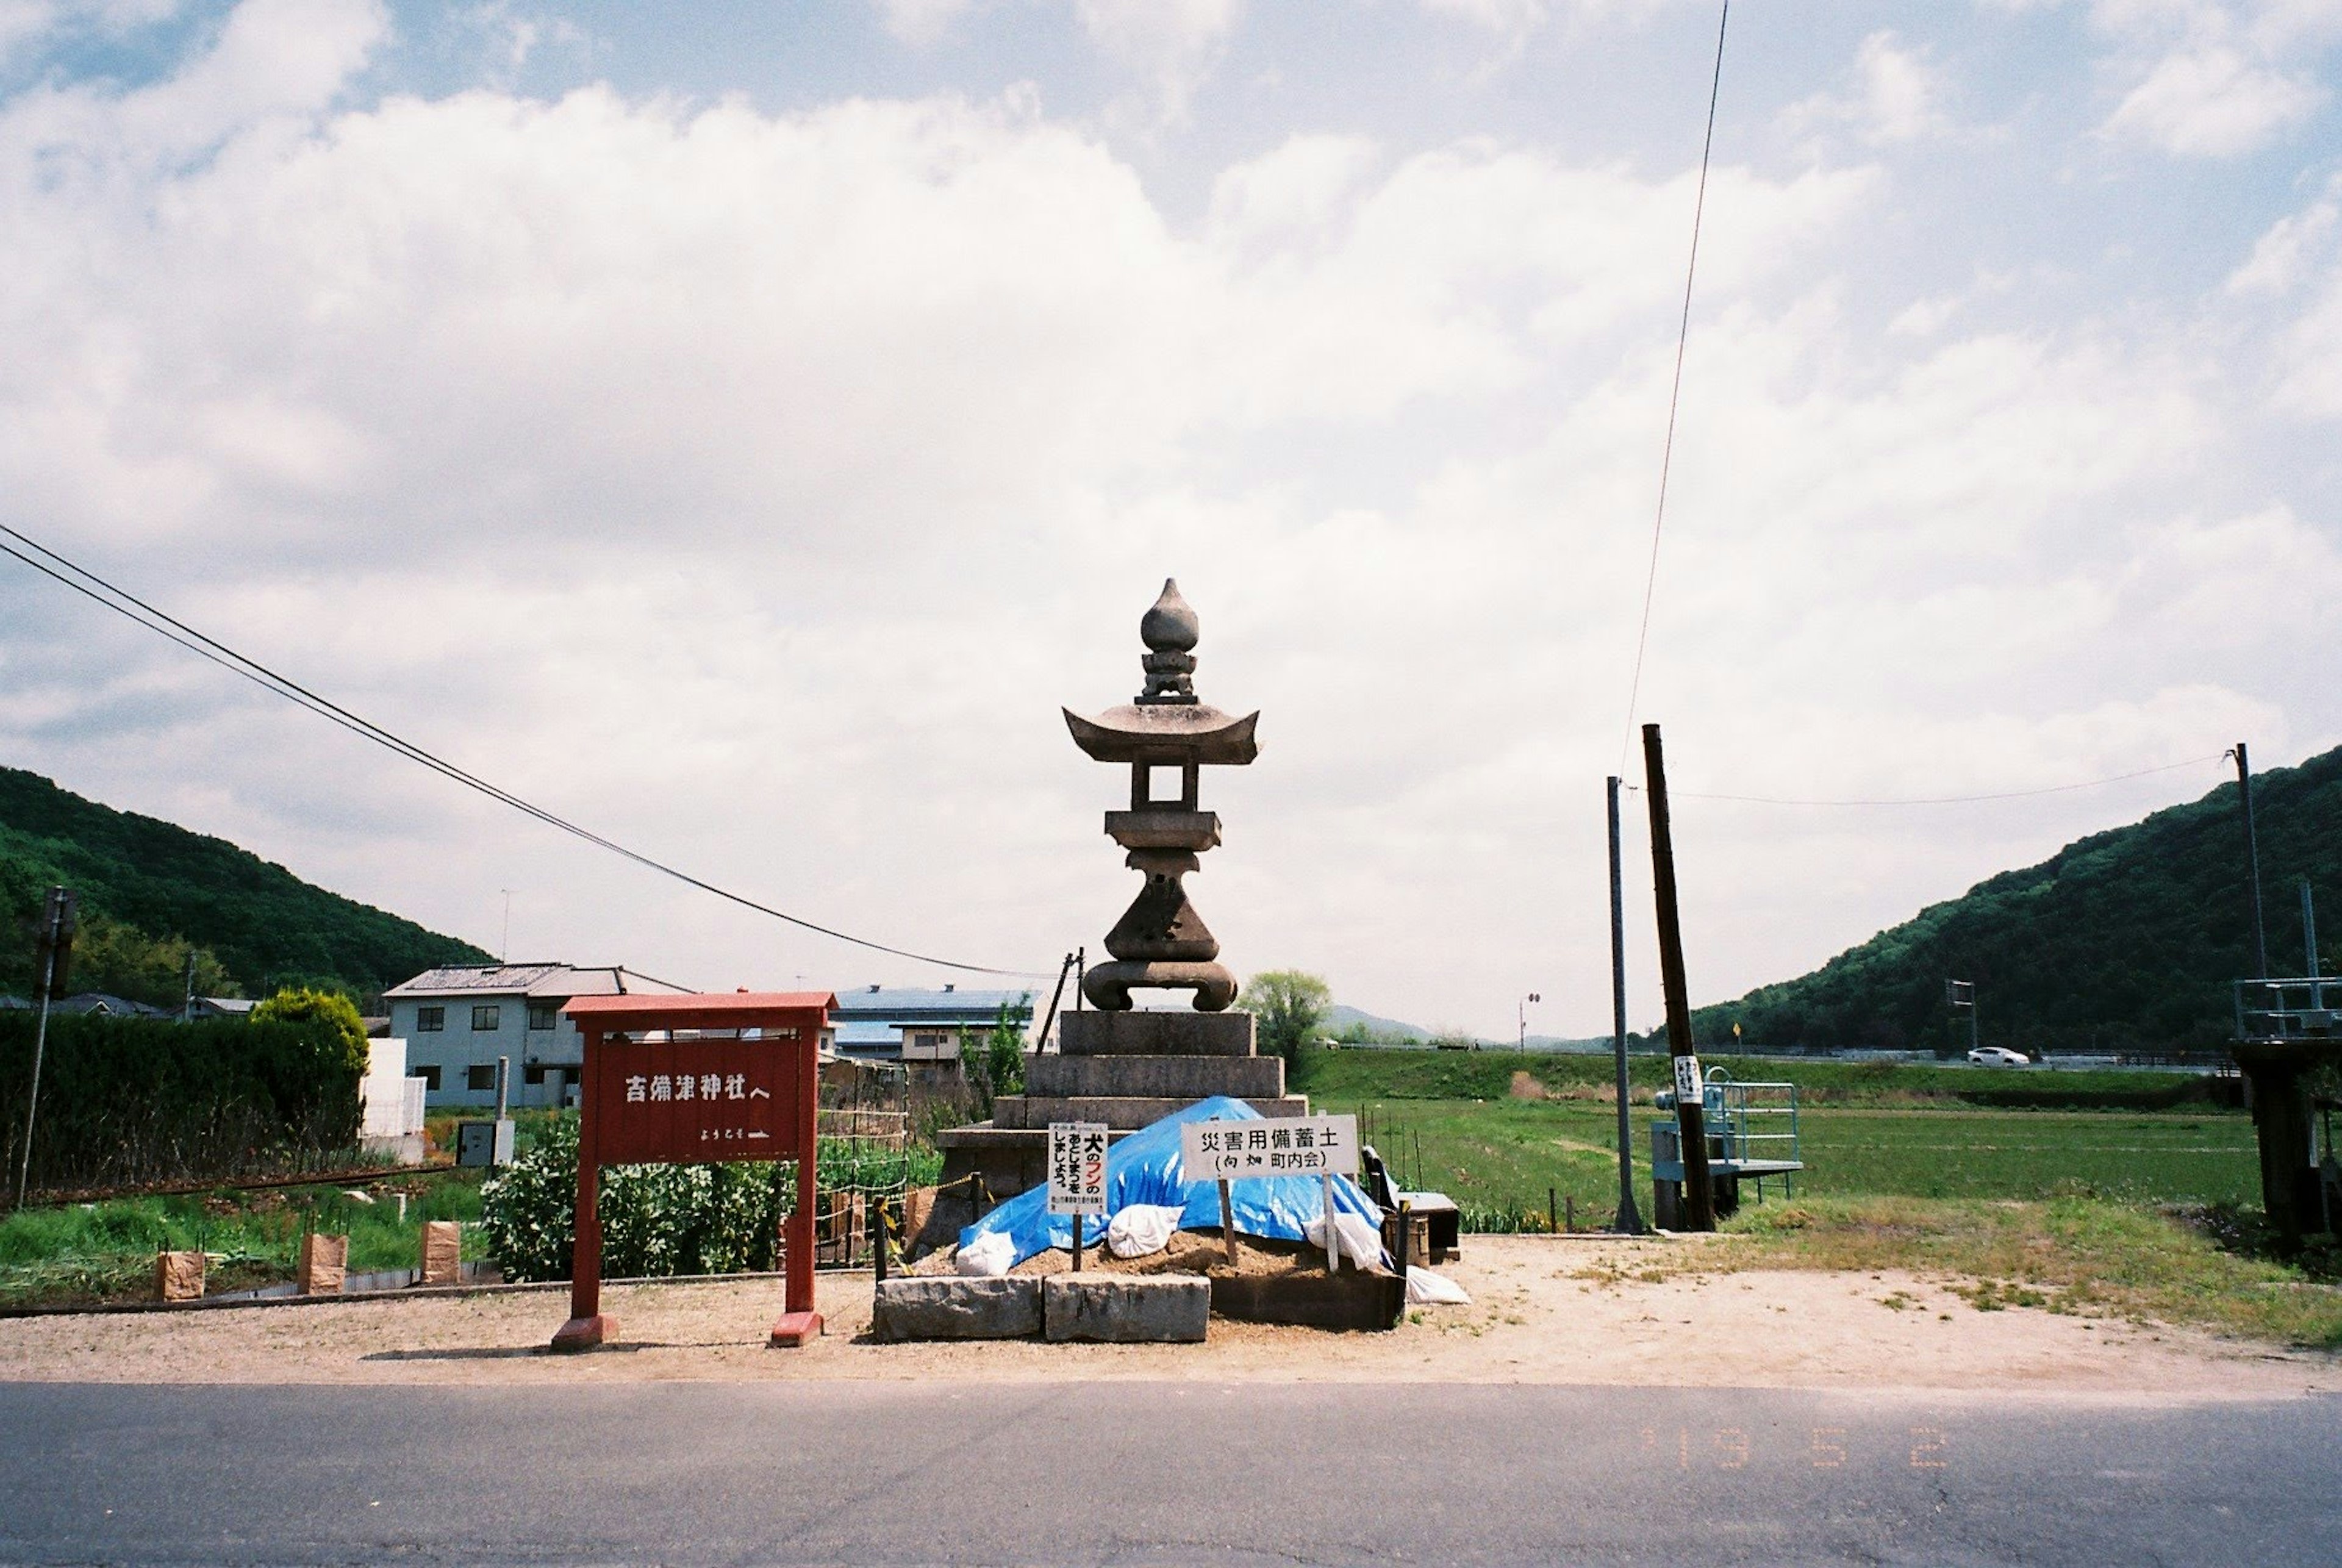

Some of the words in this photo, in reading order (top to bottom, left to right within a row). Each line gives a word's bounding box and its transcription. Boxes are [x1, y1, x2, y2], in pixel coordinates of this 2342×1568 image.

[625, 1073, 770, 1103] 吉備津神社へ
[700, 1128, 743, 1142] ようこそ
[1201, 1126, 1339, 1152] 災害用備蓄土
[1068, 1133, 1081, 1194] あとしまつを
[1084, 1133, 1103, 1194] 犬のフンの
